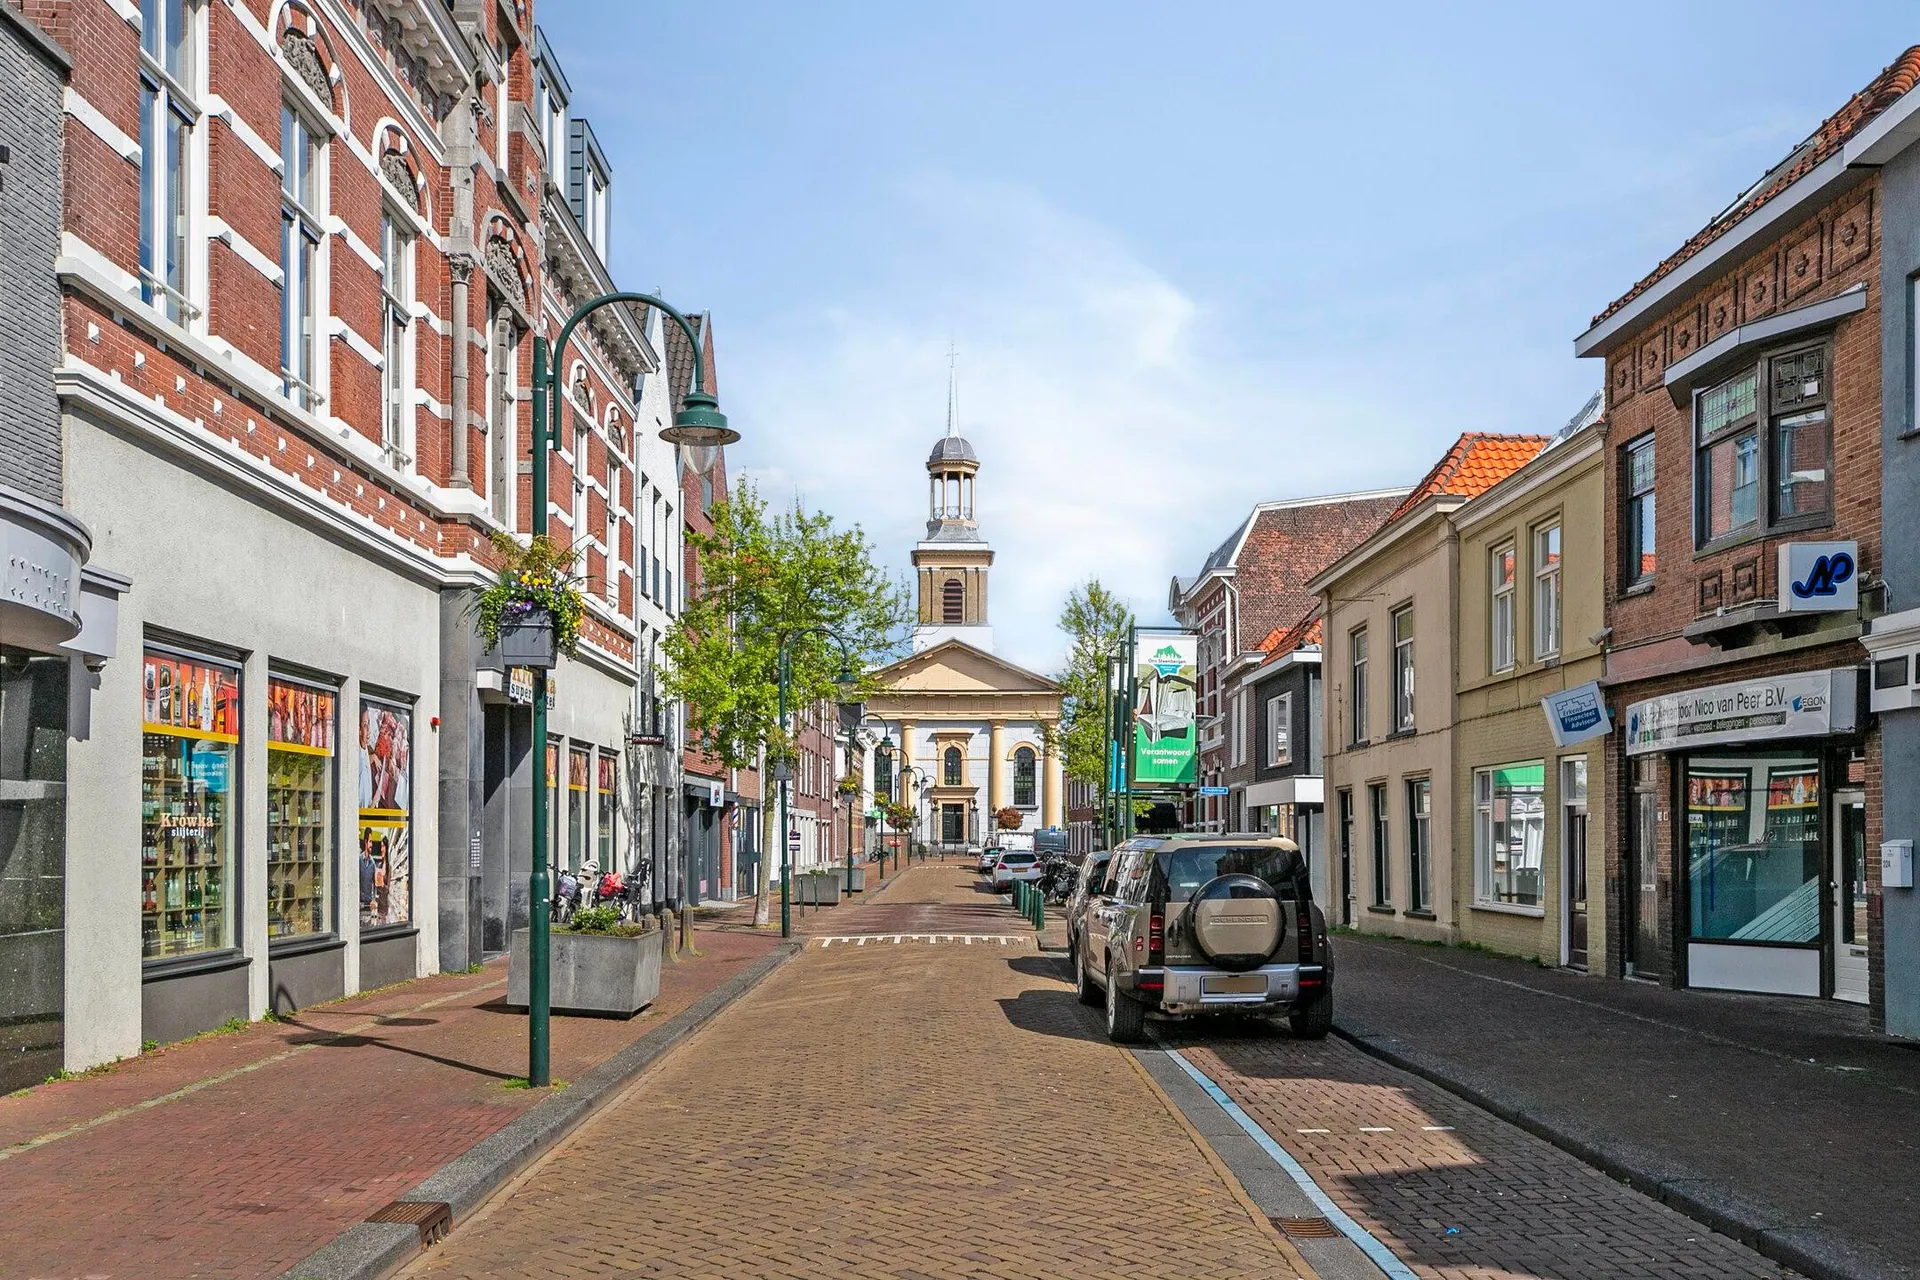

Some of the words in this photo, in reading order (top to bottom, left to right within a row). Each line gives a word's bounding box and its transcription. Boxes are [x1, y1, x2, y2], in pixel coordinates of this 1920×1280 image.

[1695, 699, 1714, 716] Nico
[1717, 698, 1733, 713] van
[1737, 693, 1761, 710] Peer
[1765, 687, 1787, 707] B.V.
[1562, 706, 1584, 717] Erkend
[1565, 710, 1595, 724] Financieel
[1571, 717, 1597, 729] Adviseur
[1716, 718, 1744, 730] beleggingen
[1140, 748, 1191, 756] Verantwoord
[160, 812, 214, 828] Krówka
[171, 827, 204, 838] slijterij
